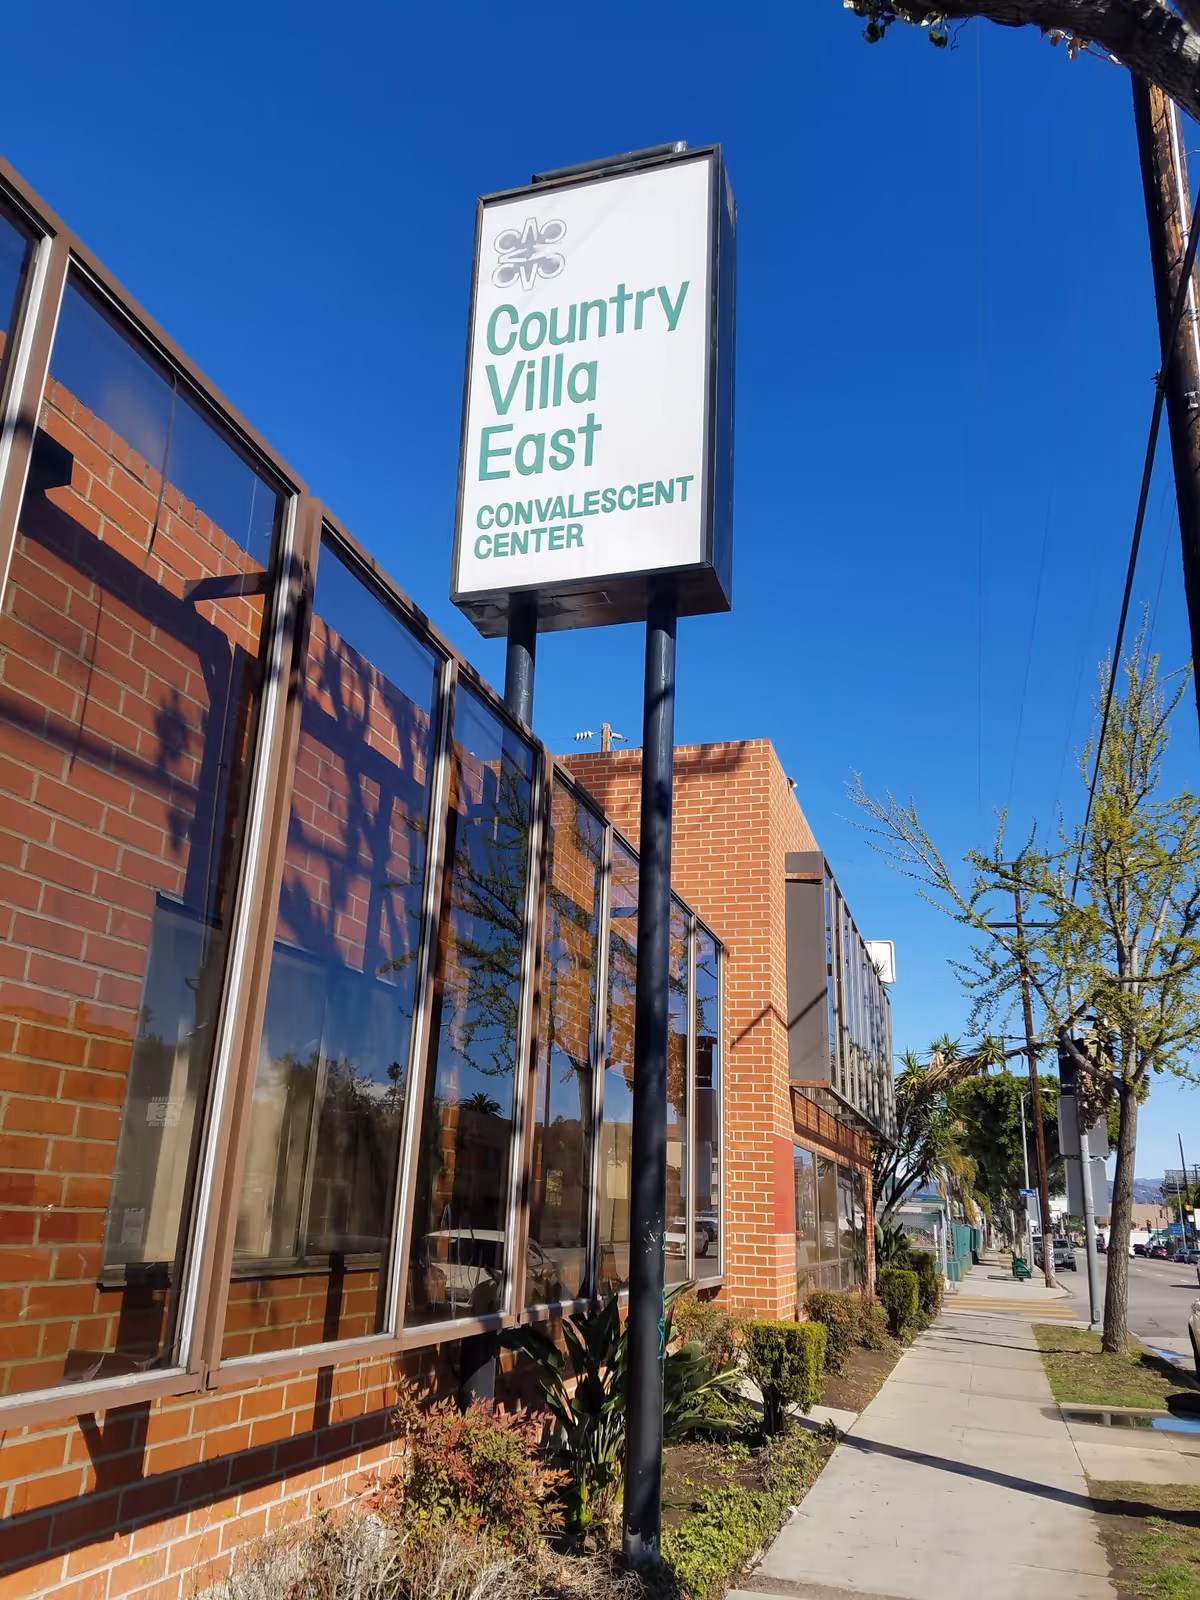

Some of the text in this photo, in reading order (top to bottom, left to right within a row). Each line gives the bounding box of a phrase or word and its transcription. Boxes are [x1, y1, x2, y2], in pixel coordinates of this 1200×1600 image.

[486, 281, 690, 356] Country
[485, 353, 598, 416] Villa
[478, 412, 603, 481] East
[476, 475, 694, 530] CONVALESCENT
[474, 523, 584, 559] CENTER
